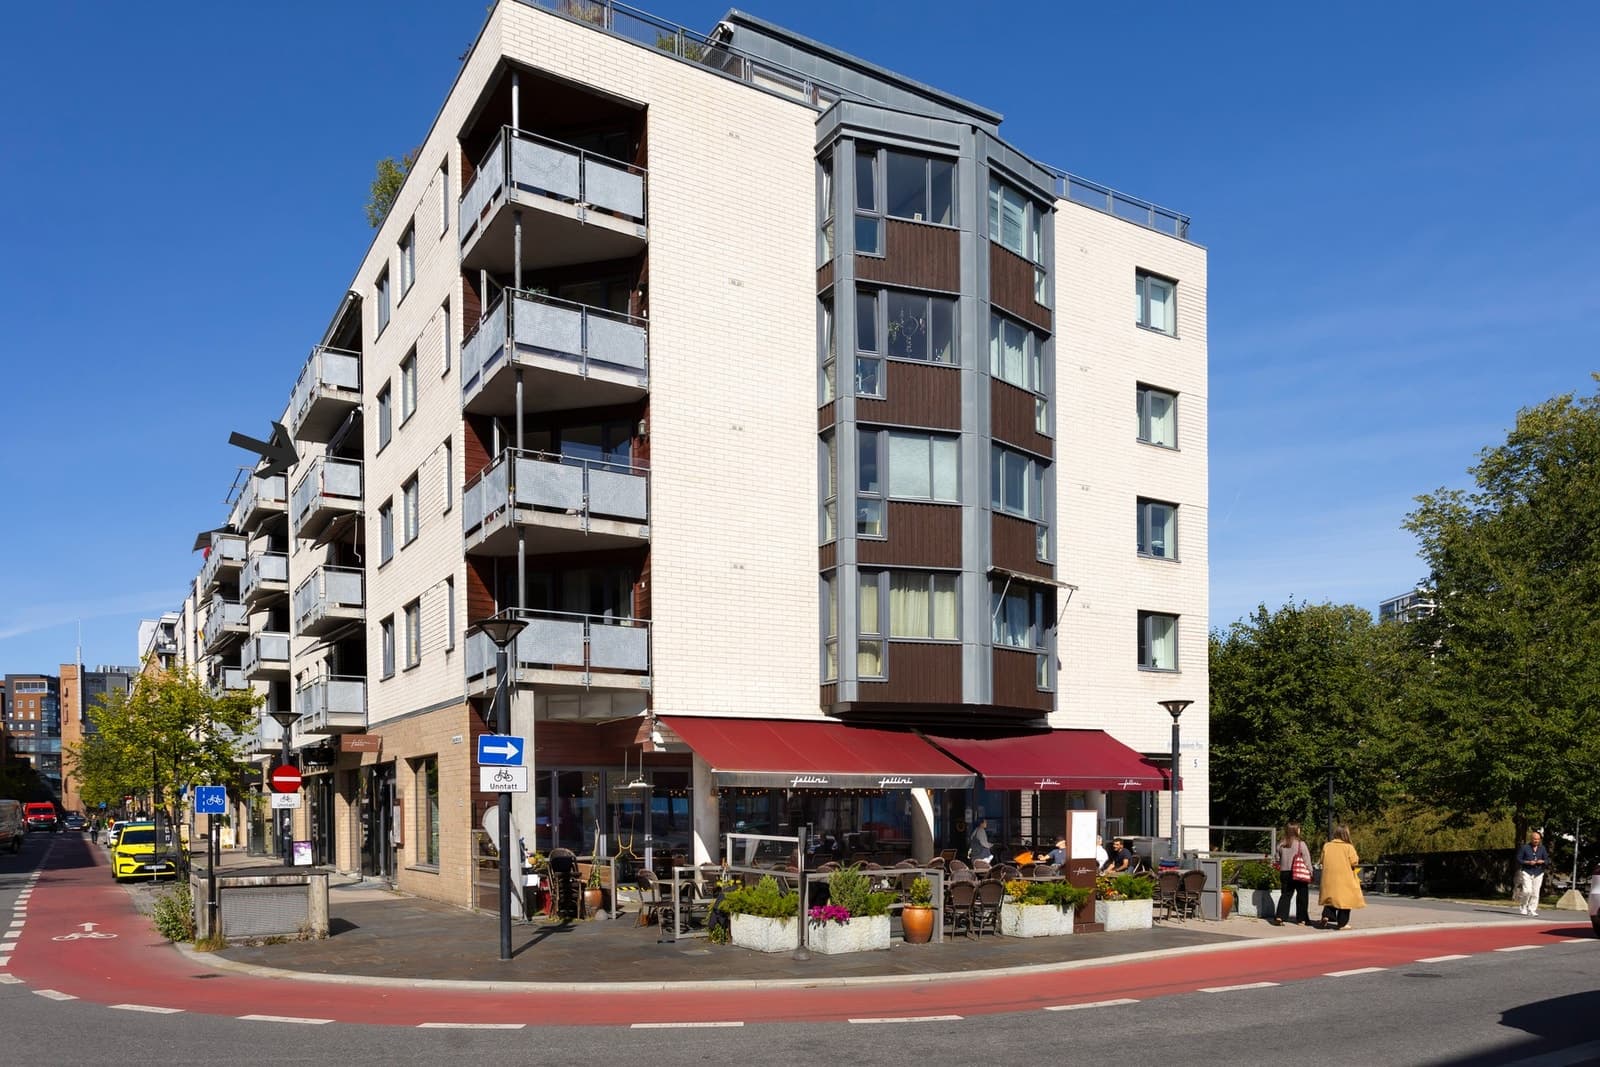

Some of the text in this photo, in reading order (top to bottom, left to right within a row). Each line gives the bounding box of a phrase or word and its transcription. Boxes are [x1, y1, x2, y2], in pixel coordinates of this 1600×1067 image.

[1193, 758, 1198, 768] 5
[790, 776, 828, 788] fellini
[878, 777, 913, 789] fellini
